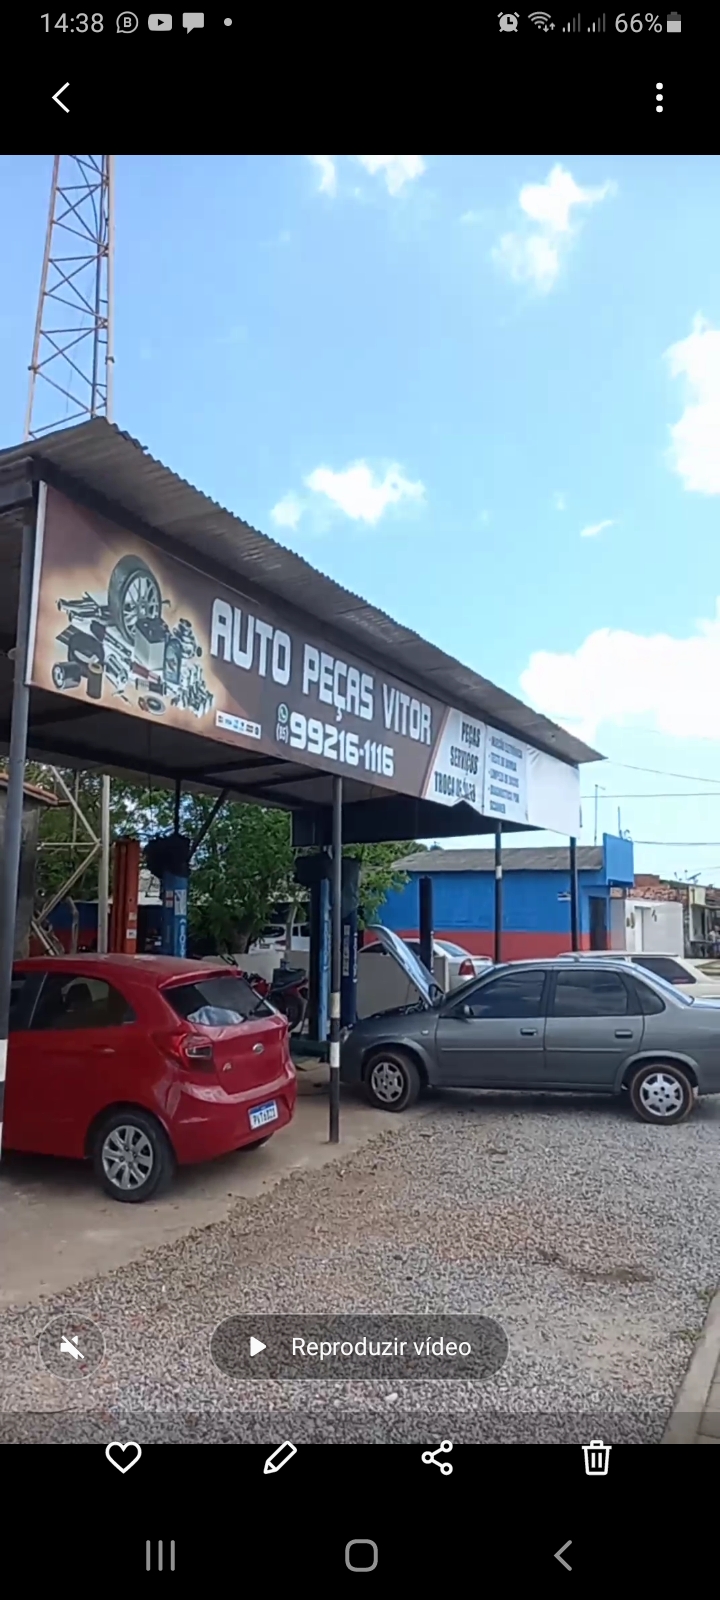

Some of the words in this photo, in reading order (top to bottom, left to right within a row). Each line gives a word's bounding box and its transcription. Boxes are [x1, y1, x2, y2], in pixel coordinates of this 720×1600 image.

[210, 597, 291, 686] AUTO
[302, 643, 374, 722] PEÇAS
[382, 682, 432, 746] VITOR
[289, 711, 394, 778] 99216-1116
[461, 721, 480, 748] PEÇAS
